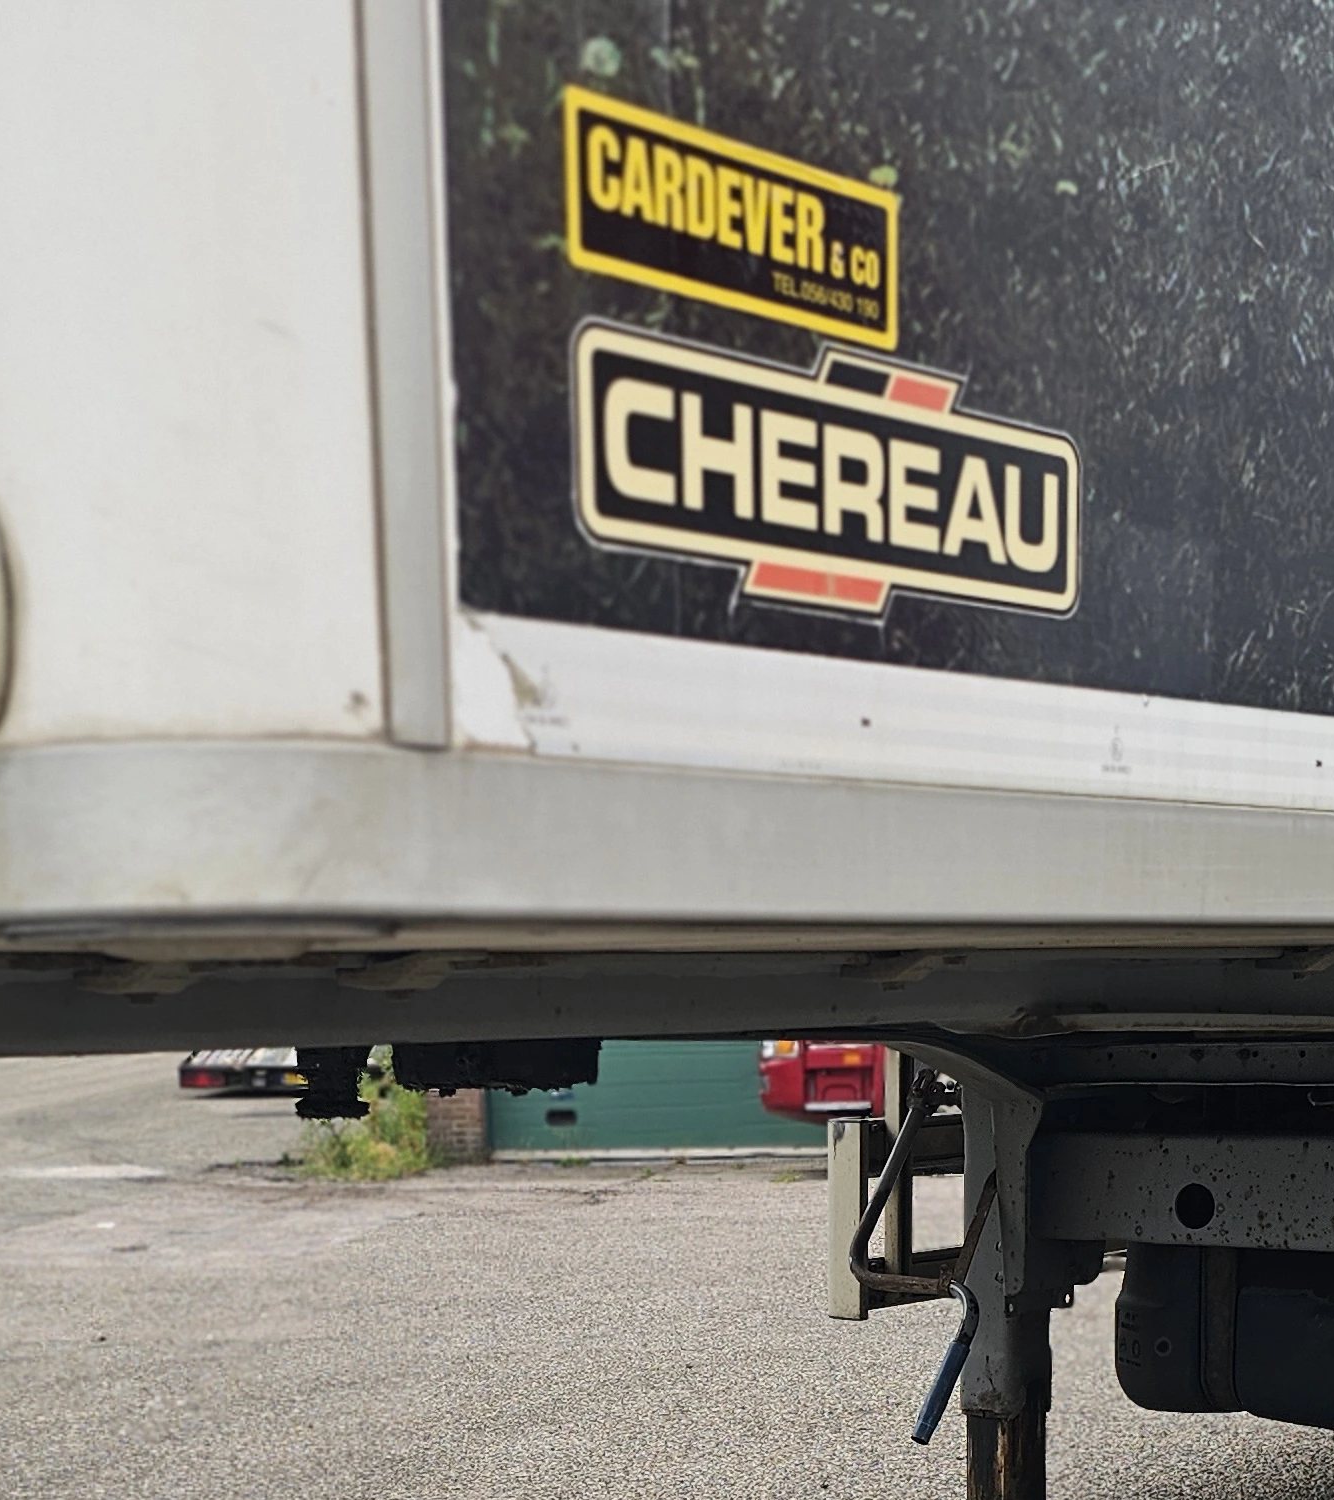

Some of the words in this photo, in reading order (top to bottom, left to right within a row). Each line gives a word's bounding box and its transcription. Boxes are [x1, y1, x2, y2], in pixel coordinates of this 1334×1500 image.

[586, 124, 825, 275] CARDEVER
[830, 240, 846, 280] &
[849, 244, 881, 290] CO
[603, 376, 1060, 573] CHEREAU
